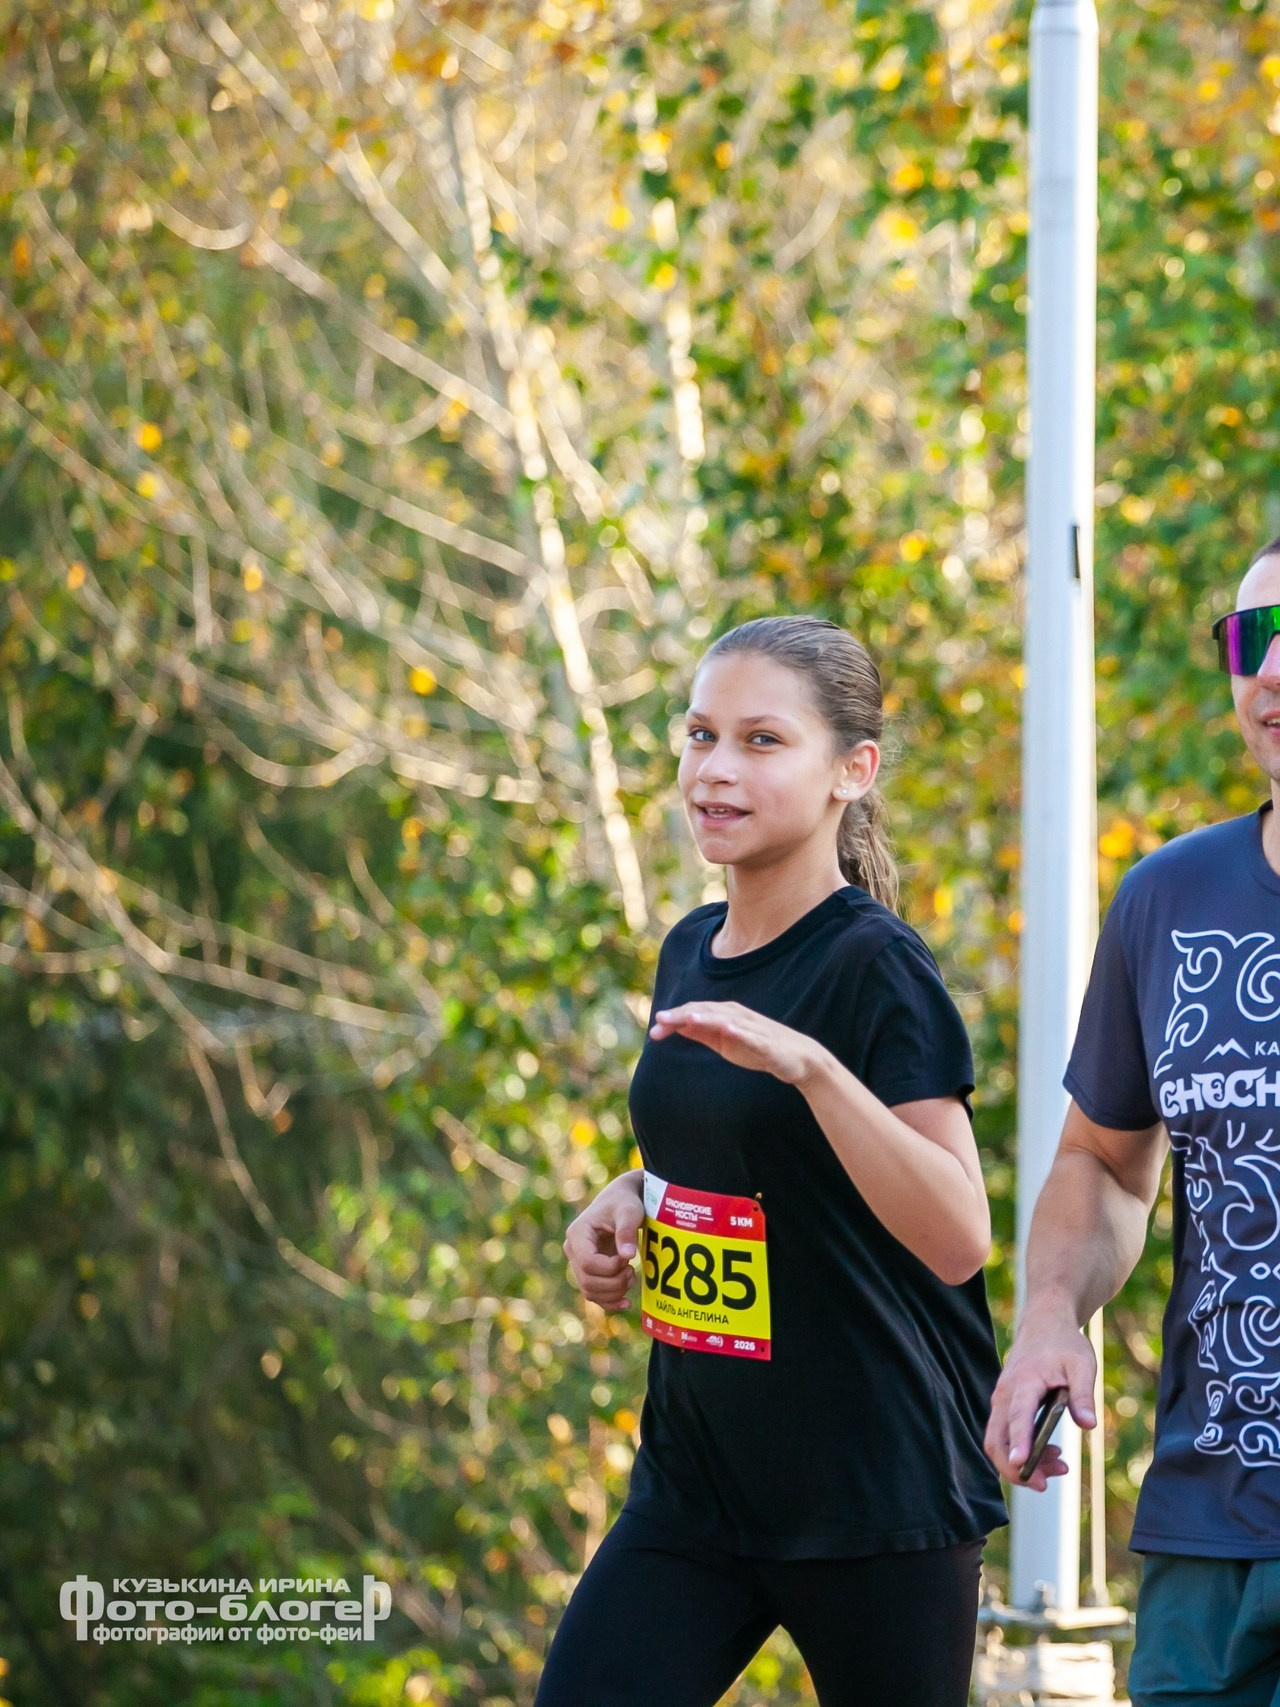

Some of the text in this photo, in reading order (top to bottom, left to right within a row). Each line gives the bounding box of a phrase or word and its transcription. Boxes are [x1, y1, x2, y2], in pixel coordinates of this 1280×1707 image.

[730, 1216, 737, 1226] 5
[645, 1226, 757, 1311] 5285
[677, 1307, 729, 1324] АНГЕЛИНА
